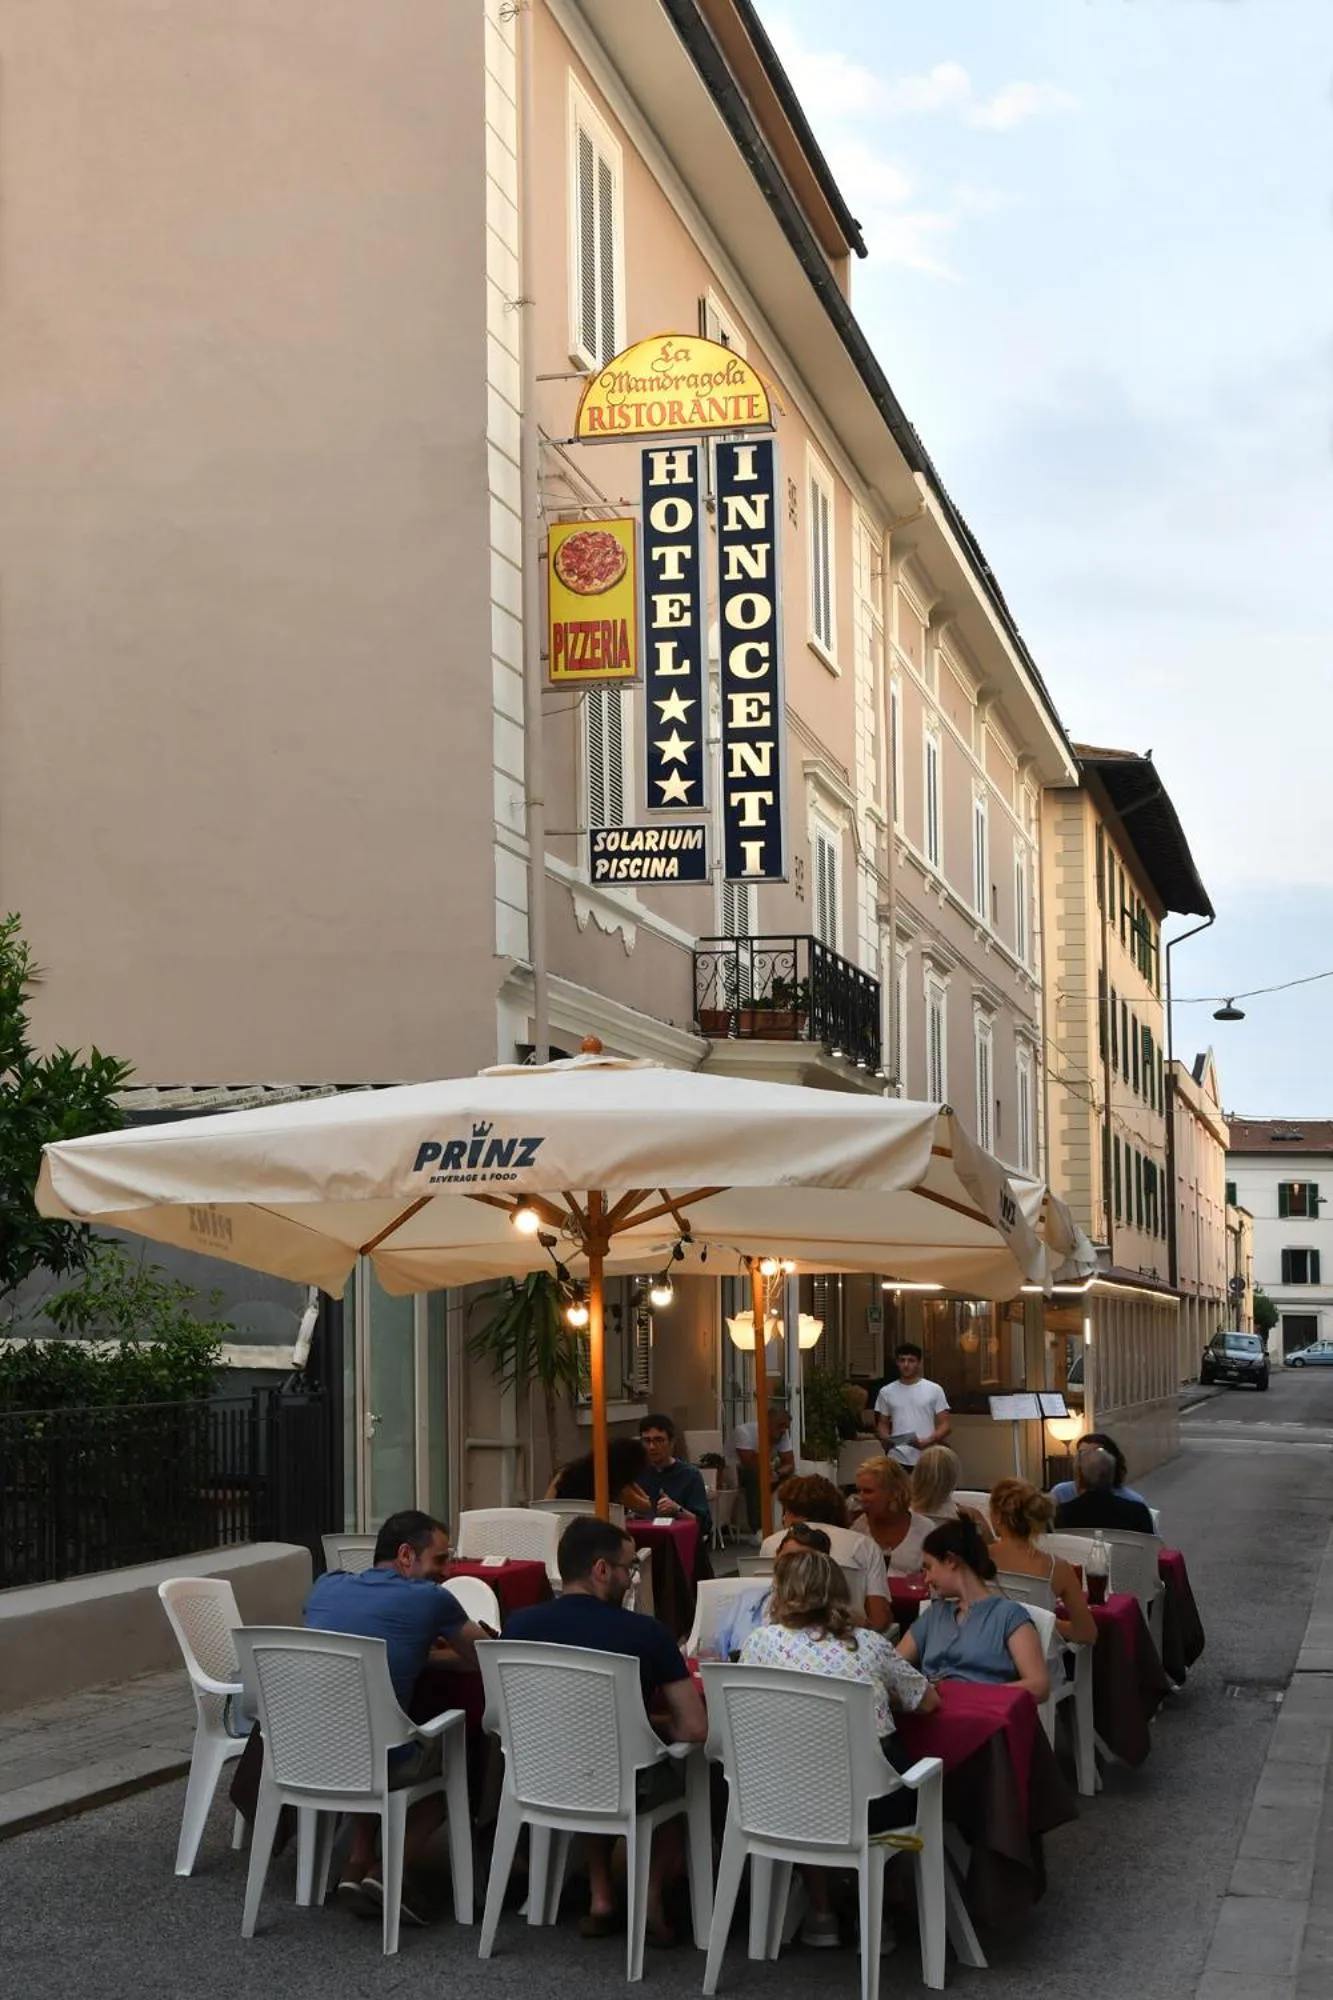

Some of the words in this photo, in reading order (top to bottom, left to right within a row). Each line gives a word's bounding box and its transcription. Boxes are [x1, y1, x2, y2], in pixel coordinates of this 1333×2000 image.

[651, 341, 692, 372] La
[600, 359, 747, 405] Mandragola
[589, 394, 763, 432] RISTORANTE
[648, 449, 694, 677] HOTEL
[553, 618, 631, 672] PIZZERIA
[723, 445, 775, 876] INNOCENTI
[593, 829, 704, 852] SOLARIUM
[595, 857, 679, 879] PISCINA
[413, 1137, 545, 1172] PRINZ
[429, 1174, 478, 1183] BEVERAGE
[480, 1173, 487, 1181] &
[489, 1172, 518, 1181] FOOD
